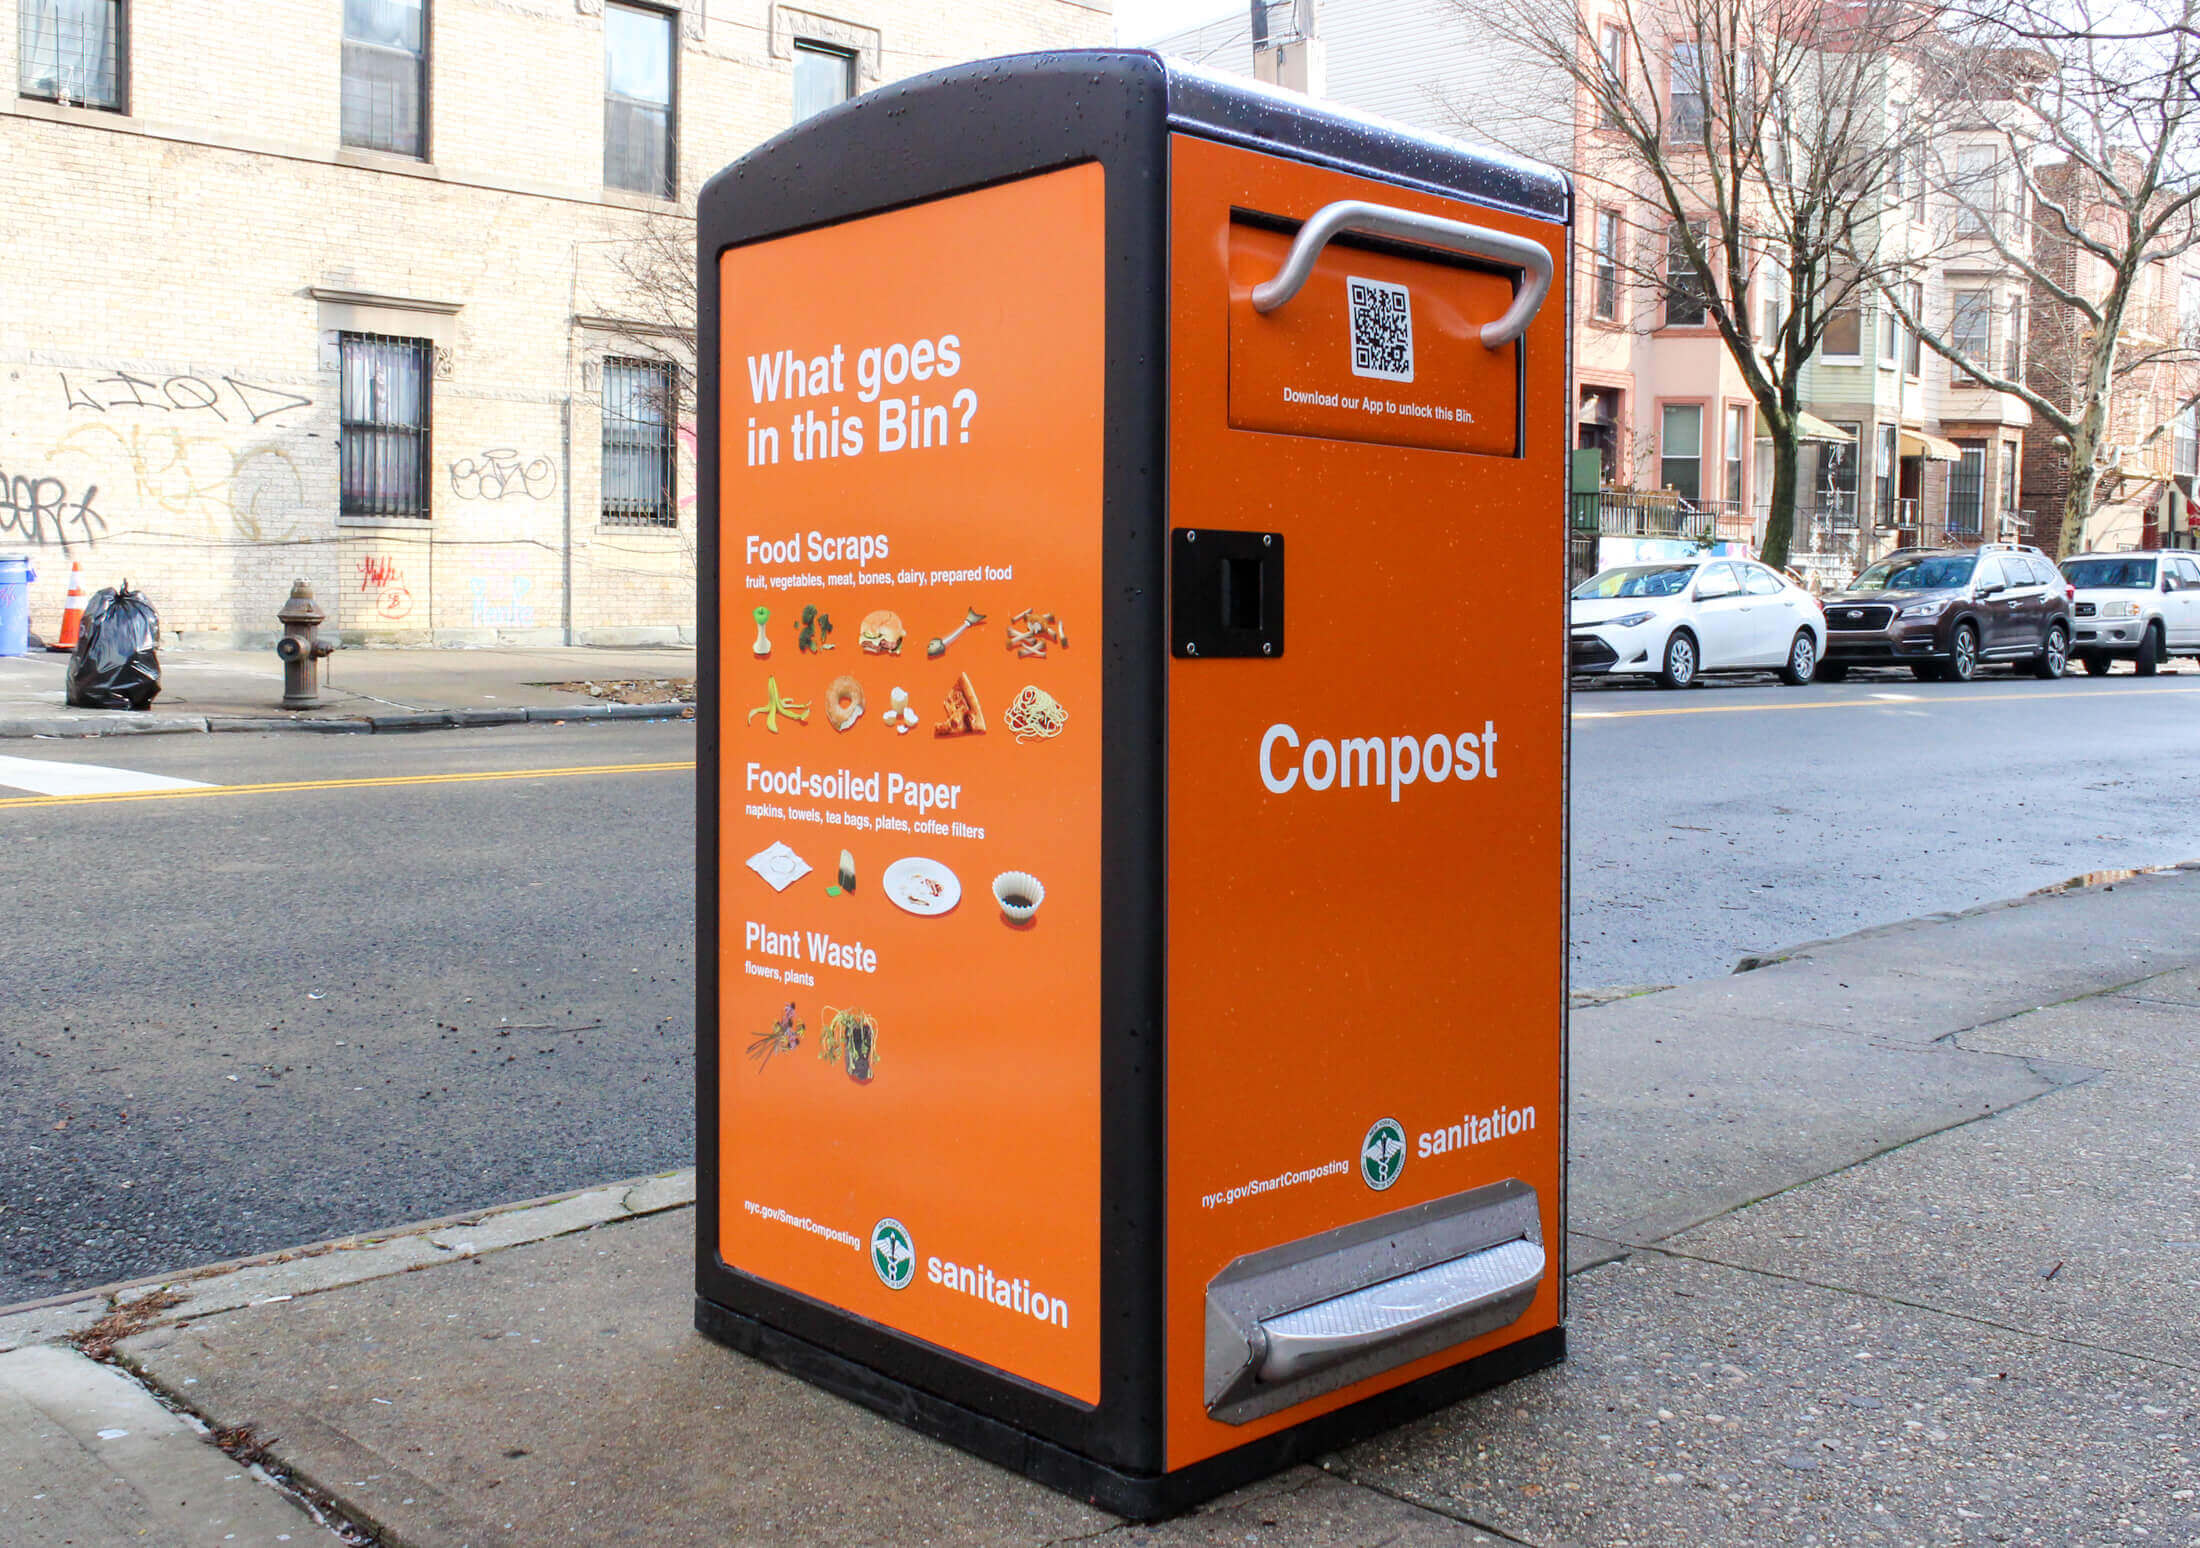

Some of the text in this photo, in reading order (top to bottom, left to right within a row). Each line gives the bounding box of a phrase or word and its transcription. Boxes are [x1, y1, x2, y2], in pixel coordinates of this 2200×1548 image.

[747, 333, 962, 404] What goes
[747, 387, 979, 467] in this Bin?
[1283, 387, 1475, 424] Download our App to unlock this Bin.
[746, 530, 889, 567] Food Scraps
[745, 564, 1013, 592] fruit, vegetables, meat, bones, dairy, prepared food
[1259, 720, 1498, 803] Compost
[746, 762, 961, 815] Food-soiled Paper
[745, 803, 986, 840] napkins, towels, tea bags, plates, coffee filters
[745, 920, 878, 974] Plant Waste
[744, 960, 815, 987] flowers, plants
[1417, 1104, 1536, 1159] sanitation
[1201, 1159, 1350, 1209] nyc.gov/SmartComposting
[744, 1199, 861, 1251] nyc.gov/SmartComposting
[927, 1255, 1069, 1329] sanitation
